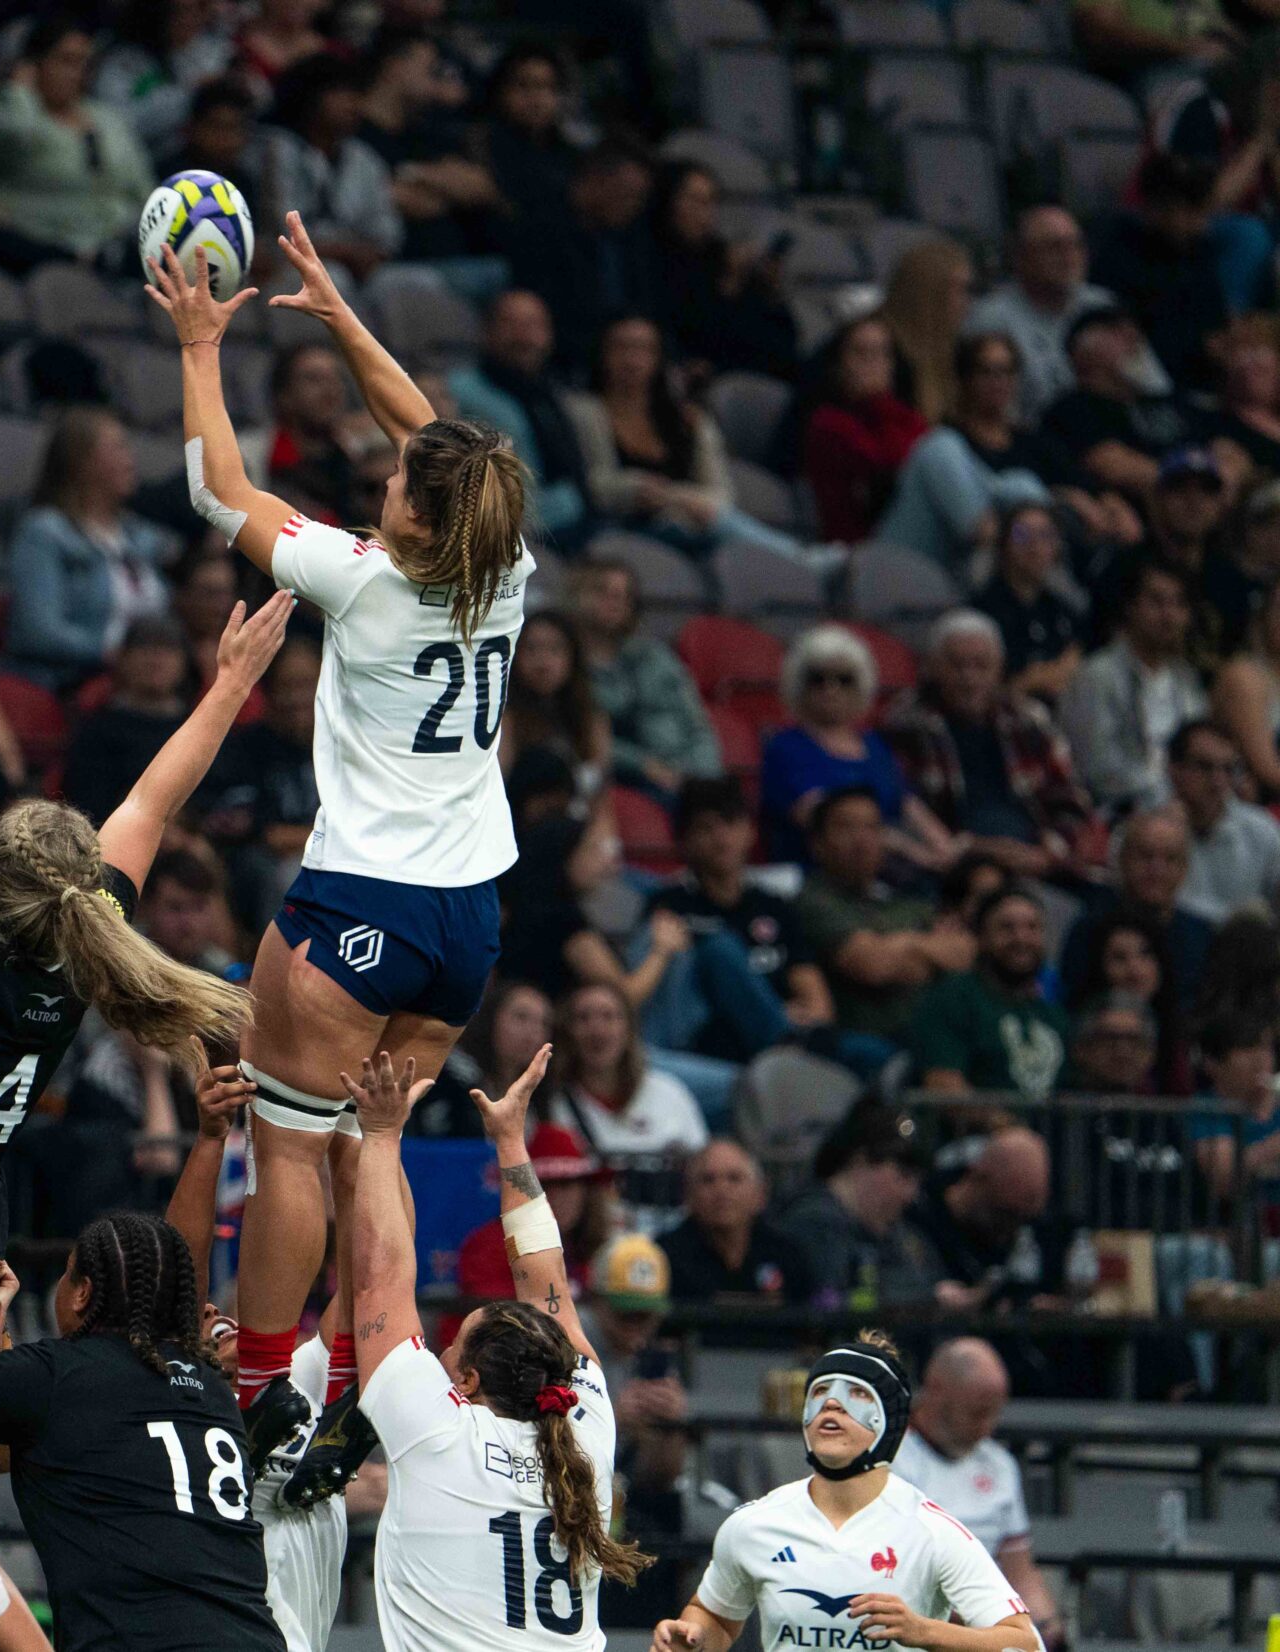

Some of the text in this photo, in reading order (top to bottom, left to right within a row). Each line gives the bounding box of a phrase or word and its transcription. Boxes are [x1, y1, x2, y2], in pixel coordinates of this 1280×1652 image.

[412, 635, 510, 753] 20
[22, 1008, 61, 1023] ALTRAD
[169, 1376, 205, 1390] ALTRAD
[146, 1421, 250, 1520] 18
[512, 1456, 544, 1470] SOC
[515, 1470, 545, 1484] GEN
[489, 1511, 584, 1635] 18
